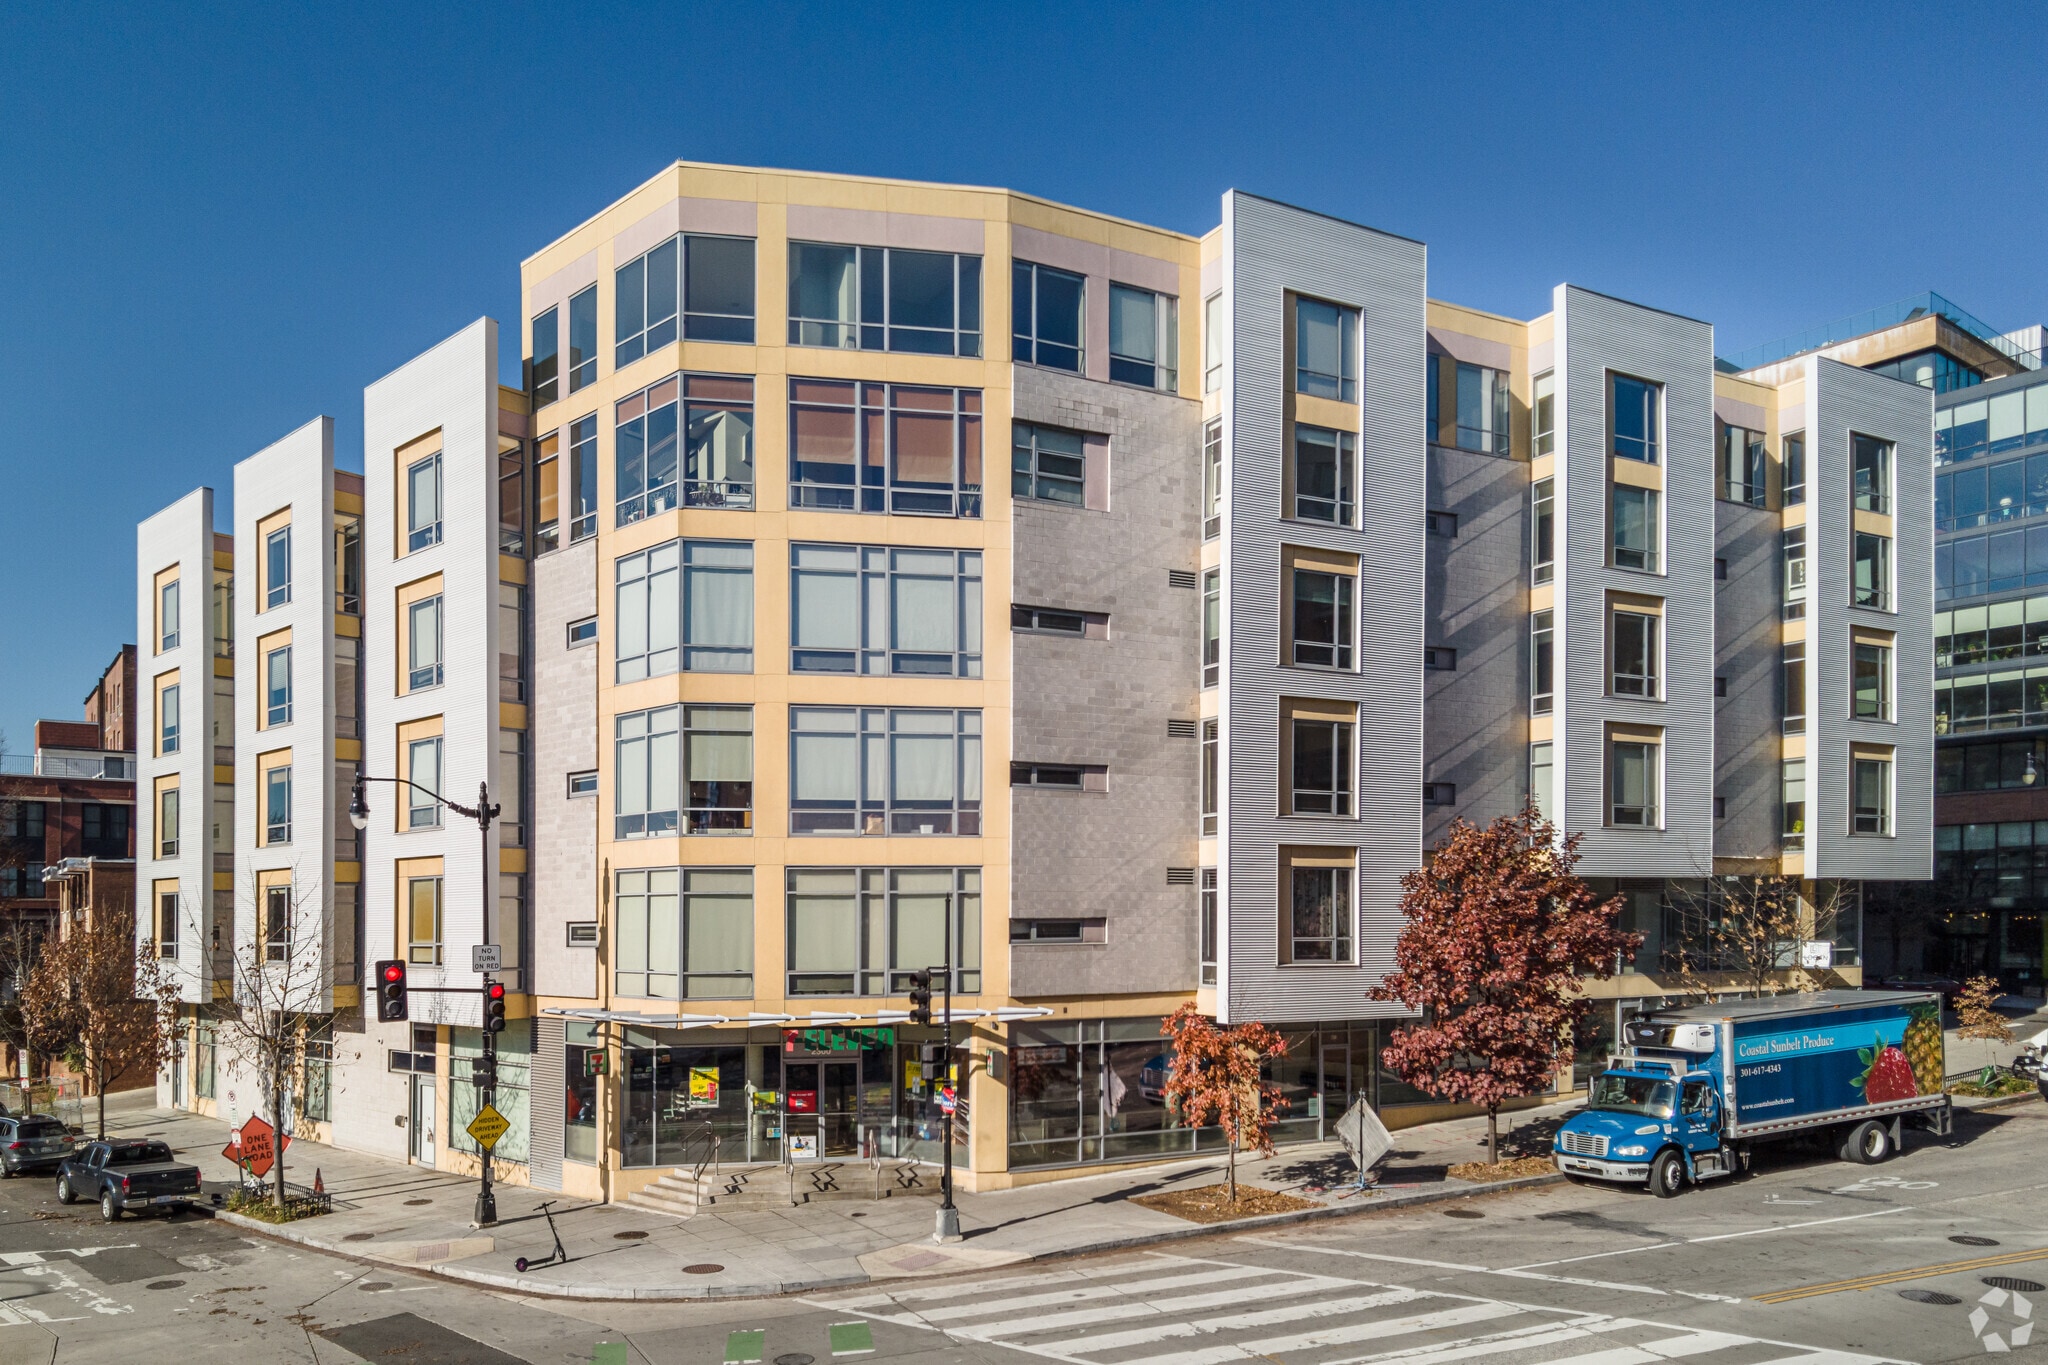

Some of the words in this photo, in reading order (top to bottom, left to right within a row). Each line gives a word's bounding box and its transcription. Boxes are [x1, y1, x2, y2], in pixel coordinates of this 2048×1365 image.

[1740, 1041, 1769, 1057] Coastal
[1771, 1037, 1801, 1053] Sunbelt
[1803, 1034, 1835, 1049] Produce
[1740, 1064, 1782, 1077] 301-617-4343
[478, 1116, 500, 1124] HIDDEN
[474, 1124, 503, 1132] DRIVEWAY
[246, 1133, 267, 1144] ONE
[479, 1132, 499, 1140] AHEAD
[244, 1142, 271, 1154] LANE
[247, 1151, 273, 1162] OAD
